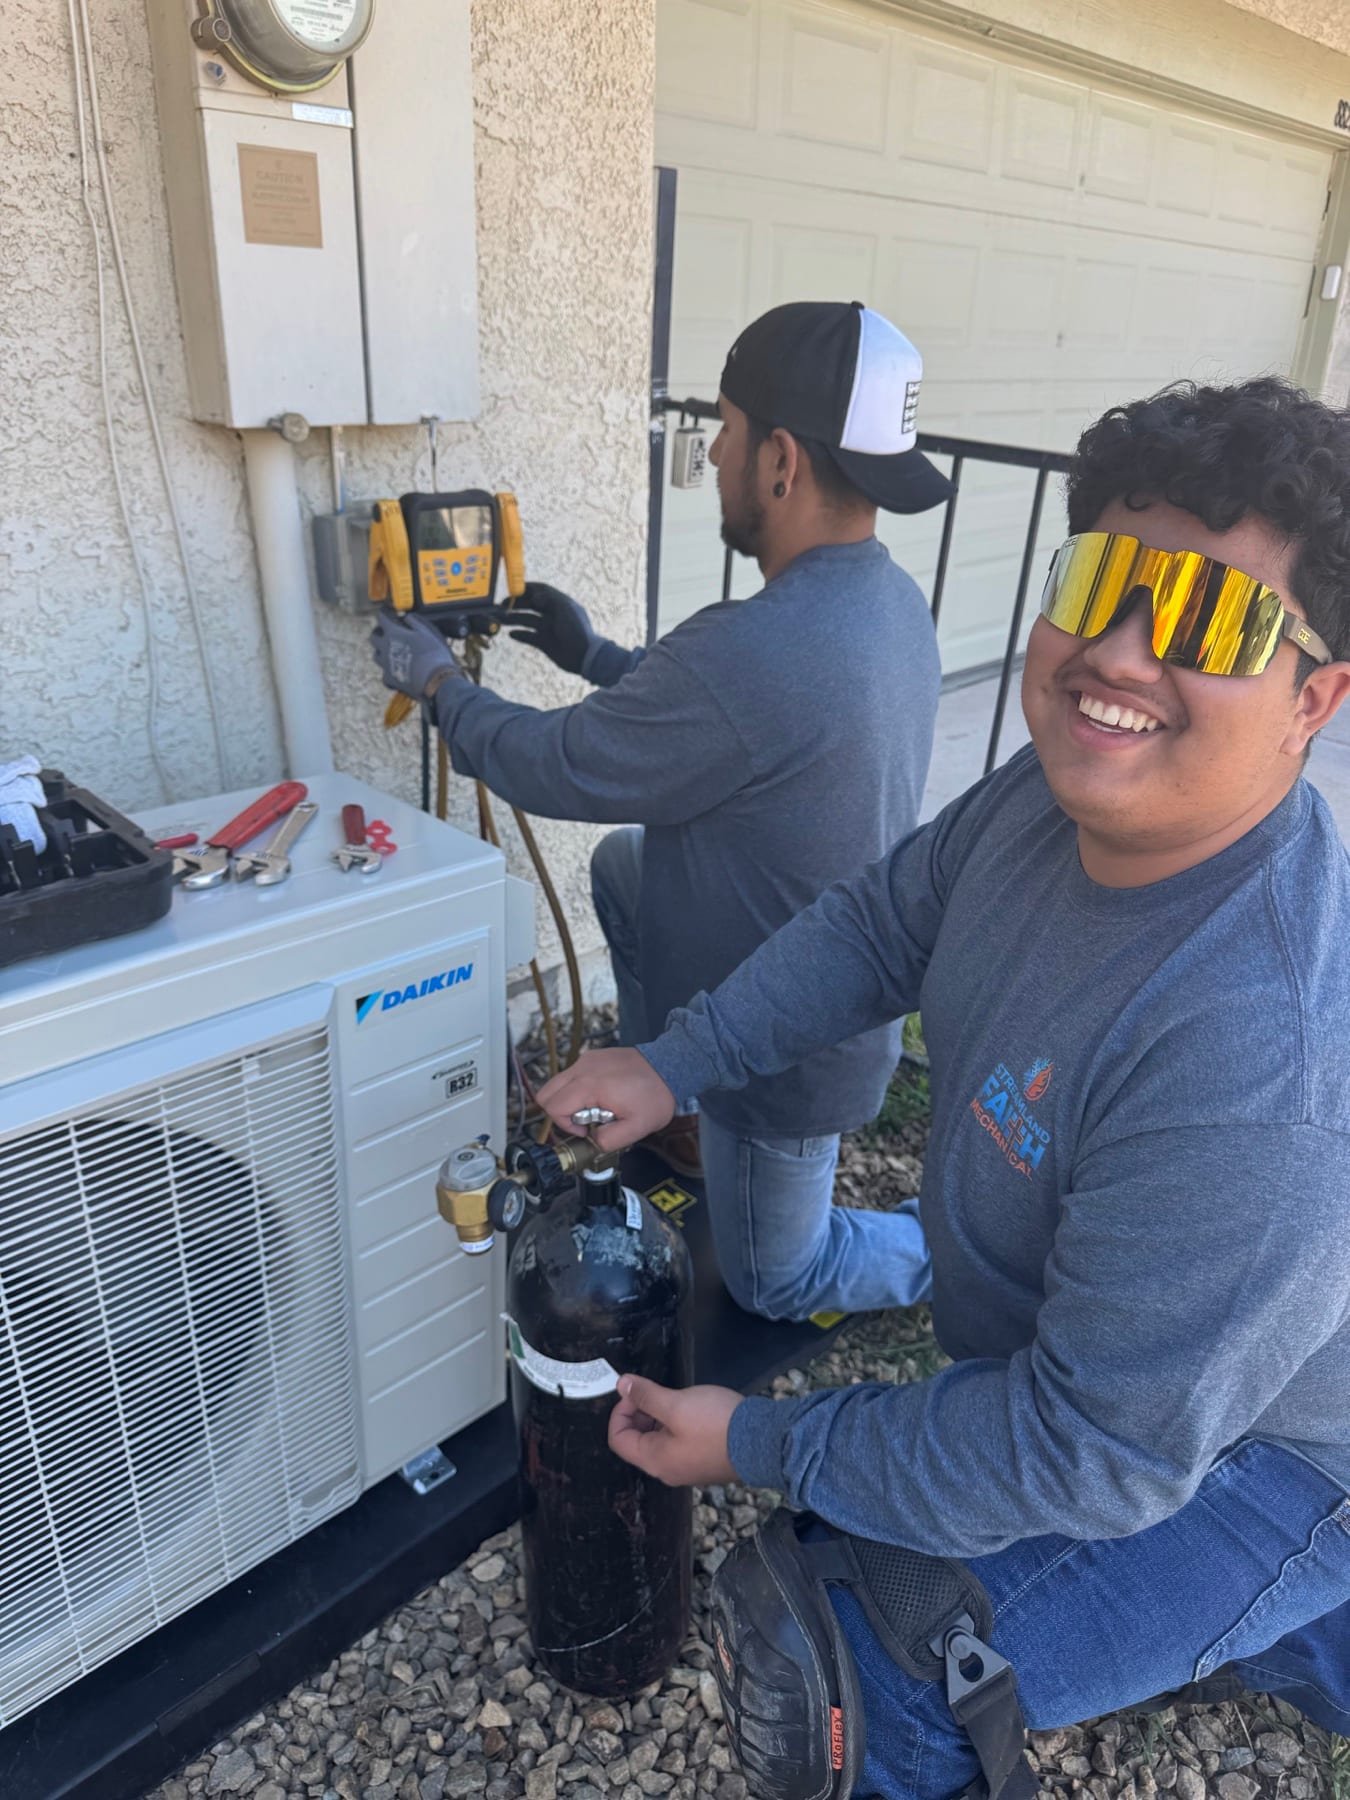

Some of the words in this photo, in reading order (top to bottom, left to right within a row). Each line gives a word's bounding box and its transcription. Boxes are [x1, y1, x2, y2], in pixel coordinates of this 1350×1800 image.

[255, 169, 304, 185] CAUTION
[381, 963, 473, 1011] DAIKIN
[450, 1072, 474, 1094] R32
[995, 1062, 1051, 1144] STREAMLAND
[970, 1097, 1033, 1181] MECHANICAL
[982, 1074, 1045, 1169] FAITH
